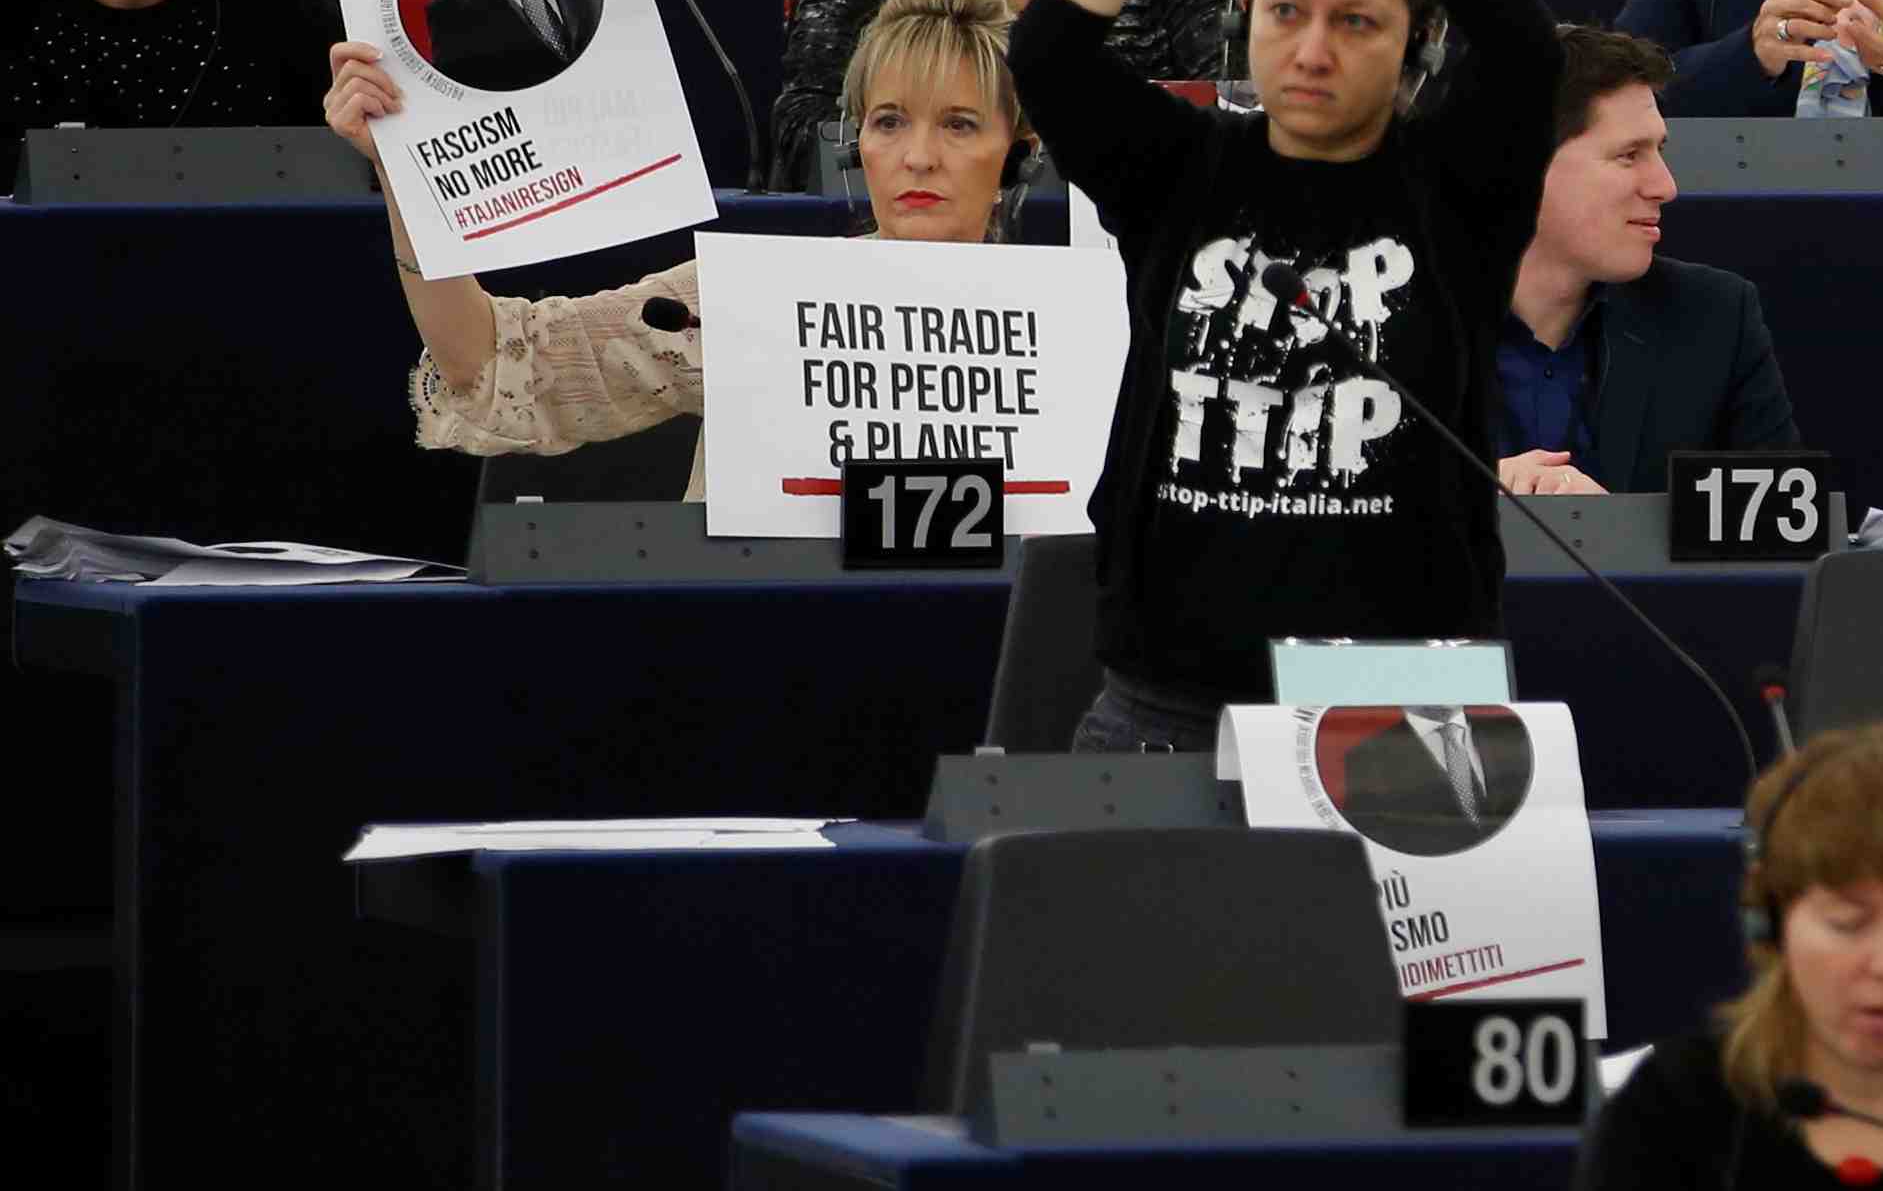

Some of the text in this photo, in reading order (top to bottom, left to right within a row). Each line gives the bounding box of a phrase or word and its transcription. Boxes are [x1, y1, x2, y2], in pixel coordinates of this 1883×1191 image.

[416, 106, 522, 169] FASCISM
[433, 139, 543, 202] NO MORE
[454, 165, 584, 230] #TAJANIRESIGN
[796, 301, 1040, 358] FAIR TRADE!
[803, 359, 1040, 415] FOR PEOPLE
[829, 420, 1020, 470] & PLANET
[867, 473, 993, 549] 172
[1158, 483, 1394, 518] stop-ttip-italia.net
[1695, 467, 1819, 543] 173
[1401, 943, 1504, 988] IDIMETTITI
[1473, 1015, 1577, 1104] 80
